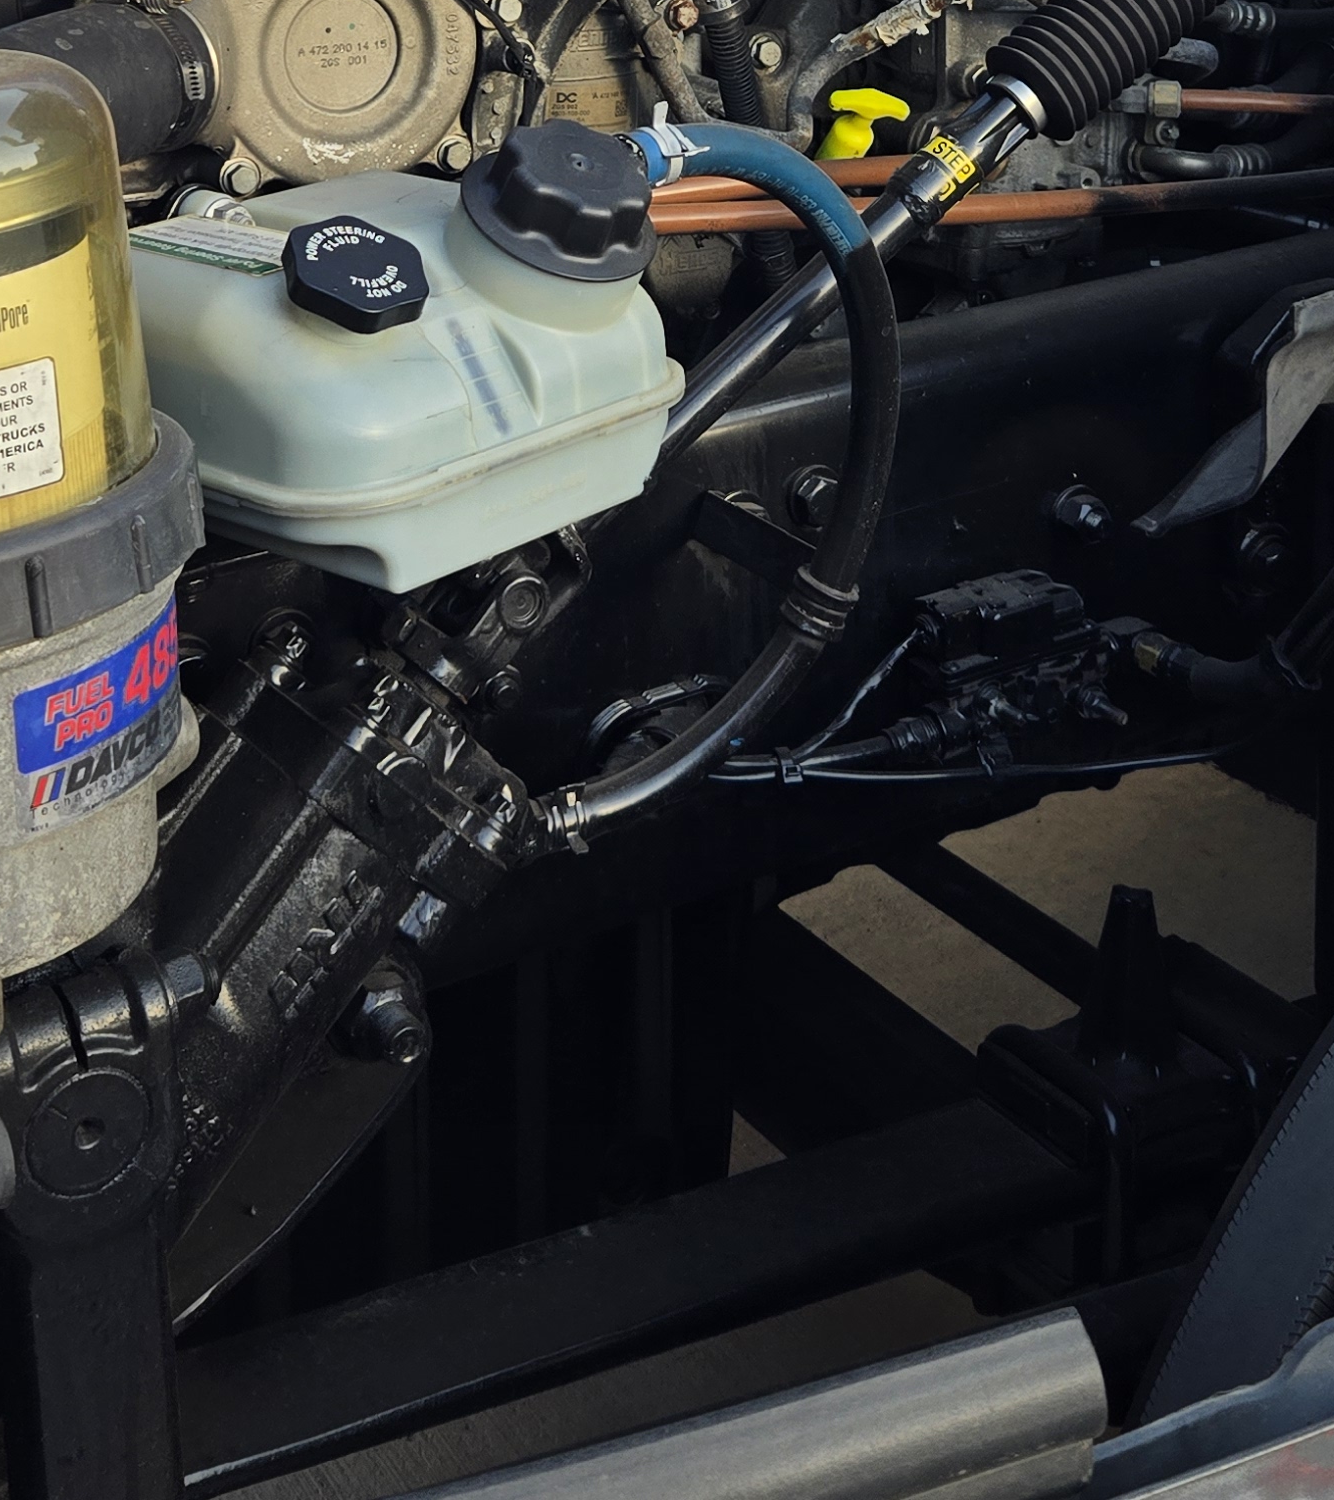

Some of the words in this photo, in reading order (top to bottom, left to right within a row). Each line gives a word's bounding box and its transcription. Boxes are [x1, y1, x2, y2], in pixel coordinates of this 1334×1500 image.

[556, 92, 578, 104] DC
[932, 141, 971, 175] STEP
[305, 232, 327, 261] POWER
[322, 226, 386, 244] STEERING
[322, 235, 360, 252] FLUID
[349, 265, 399, 288] OVERFILL
[390, 280, 408, 293] DO
[366, 288, 393, 298] NOT
[10, 381, 28, 394] OR
[44, 671, 115, 726] FUEL
[54, 699, 115, 752] PRO
[64, 709, 161, 796] DAVCO
